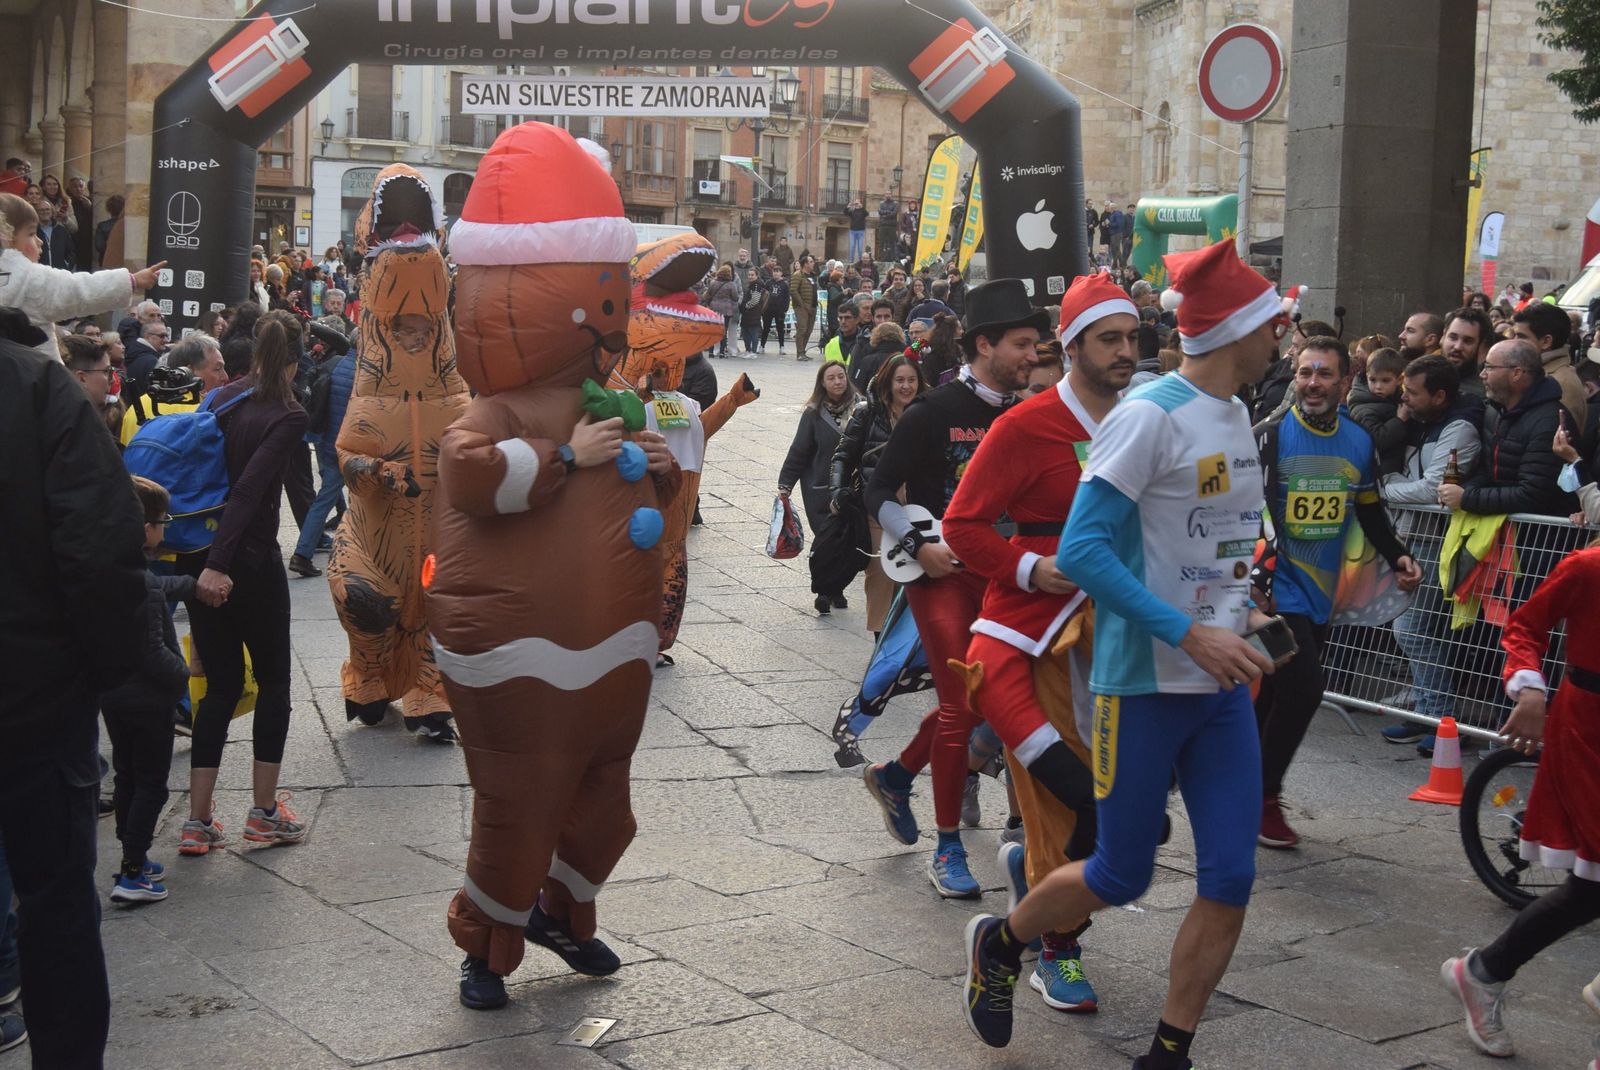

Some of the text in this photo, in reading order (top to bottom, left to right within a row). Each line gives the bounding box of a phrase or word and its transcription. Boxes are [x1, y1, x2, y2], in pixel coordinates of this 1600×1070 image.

[384, 43, 839, 61] Cirugía oral e implantes dentales
[466, 83, 766, 108] SAN SILVESTRE ZAMORANA
[158, 157, 207, 171] 3shape
[1017, 163, 1062, 176] invisalign
[1176, 207, 1202, 222] RURAL
[165, 234, 200, 247] DSD
[1293, 495, 1341, 521] 623
